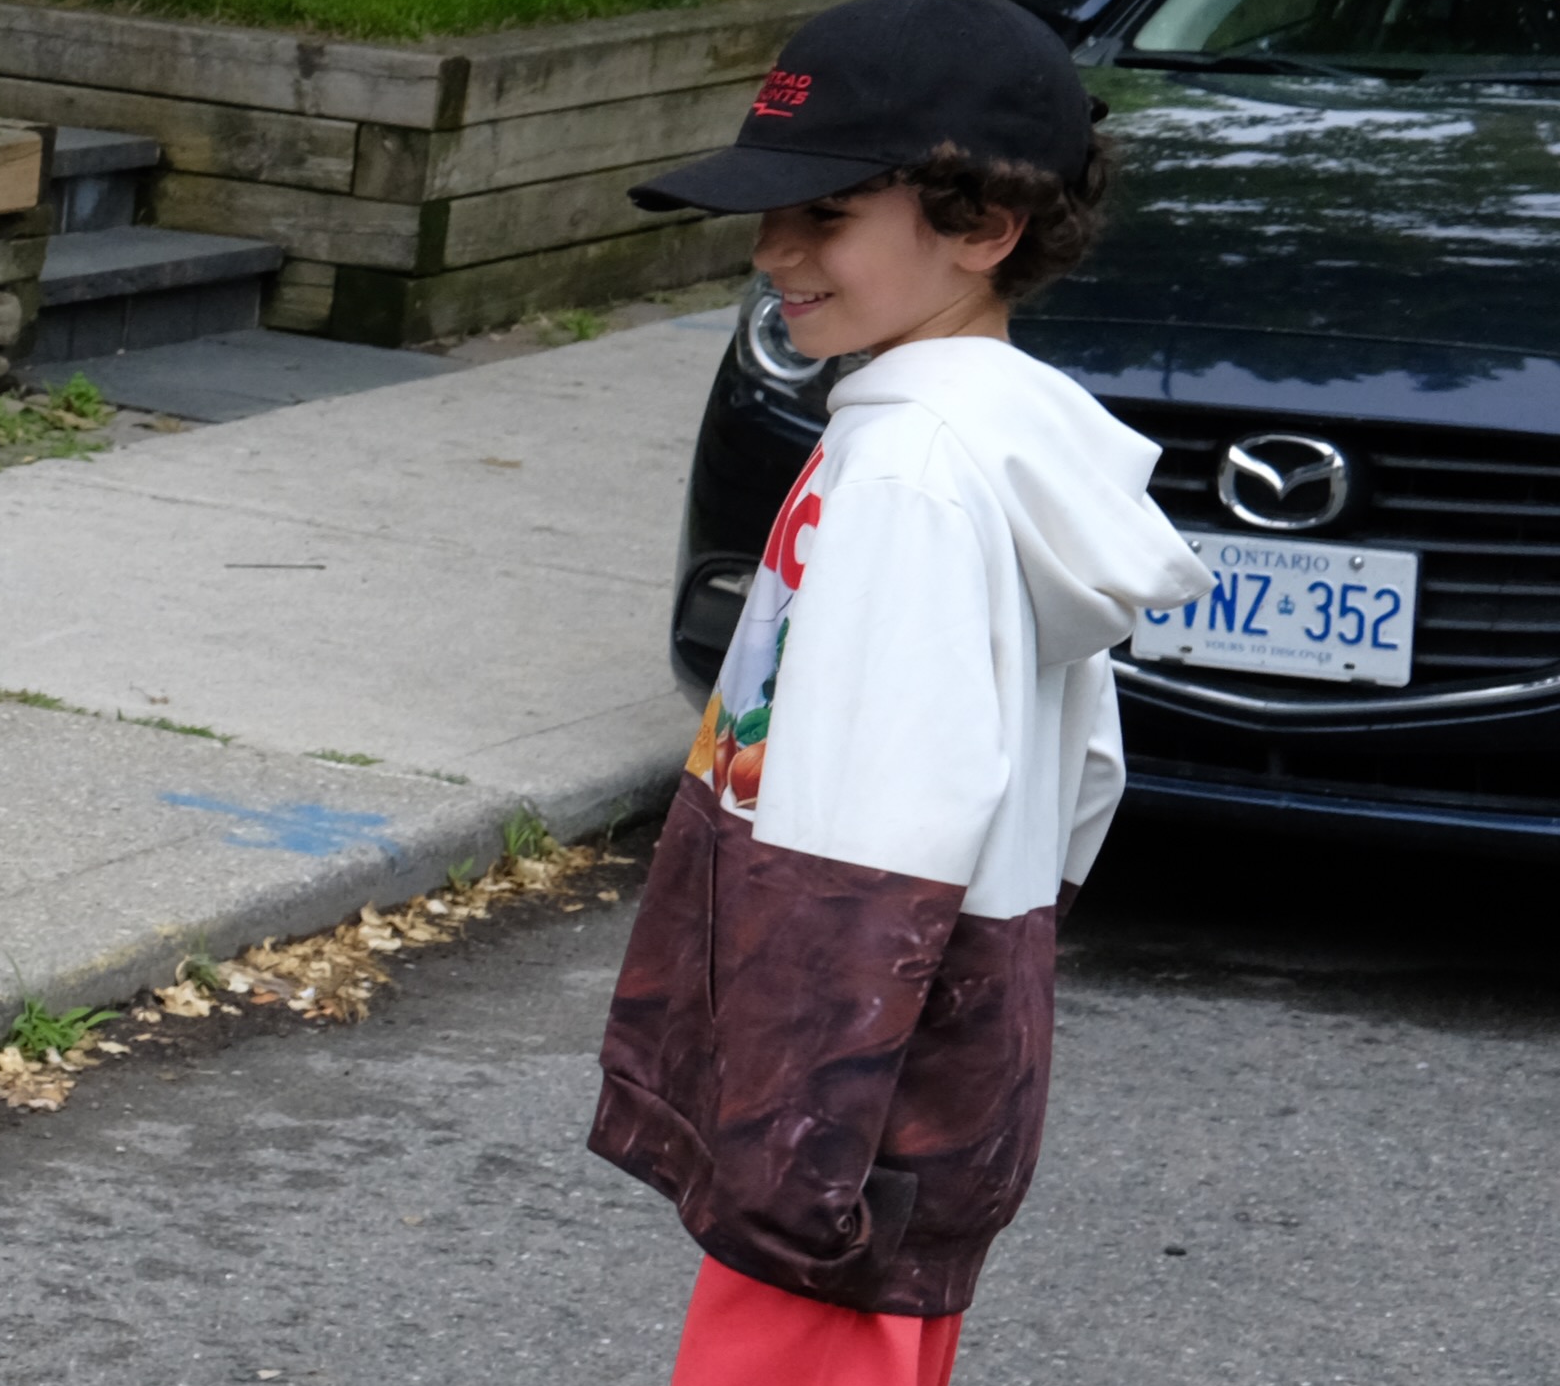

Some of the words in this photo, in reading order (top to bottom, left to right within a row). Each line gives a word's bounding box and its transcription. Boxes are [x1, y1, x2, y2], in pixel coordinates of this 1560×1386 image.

[1220, 545, 1330, 573] ONTARIO
[1304, 580, 1402, 651] 352
[1250, 644, 1266, 655] TO
